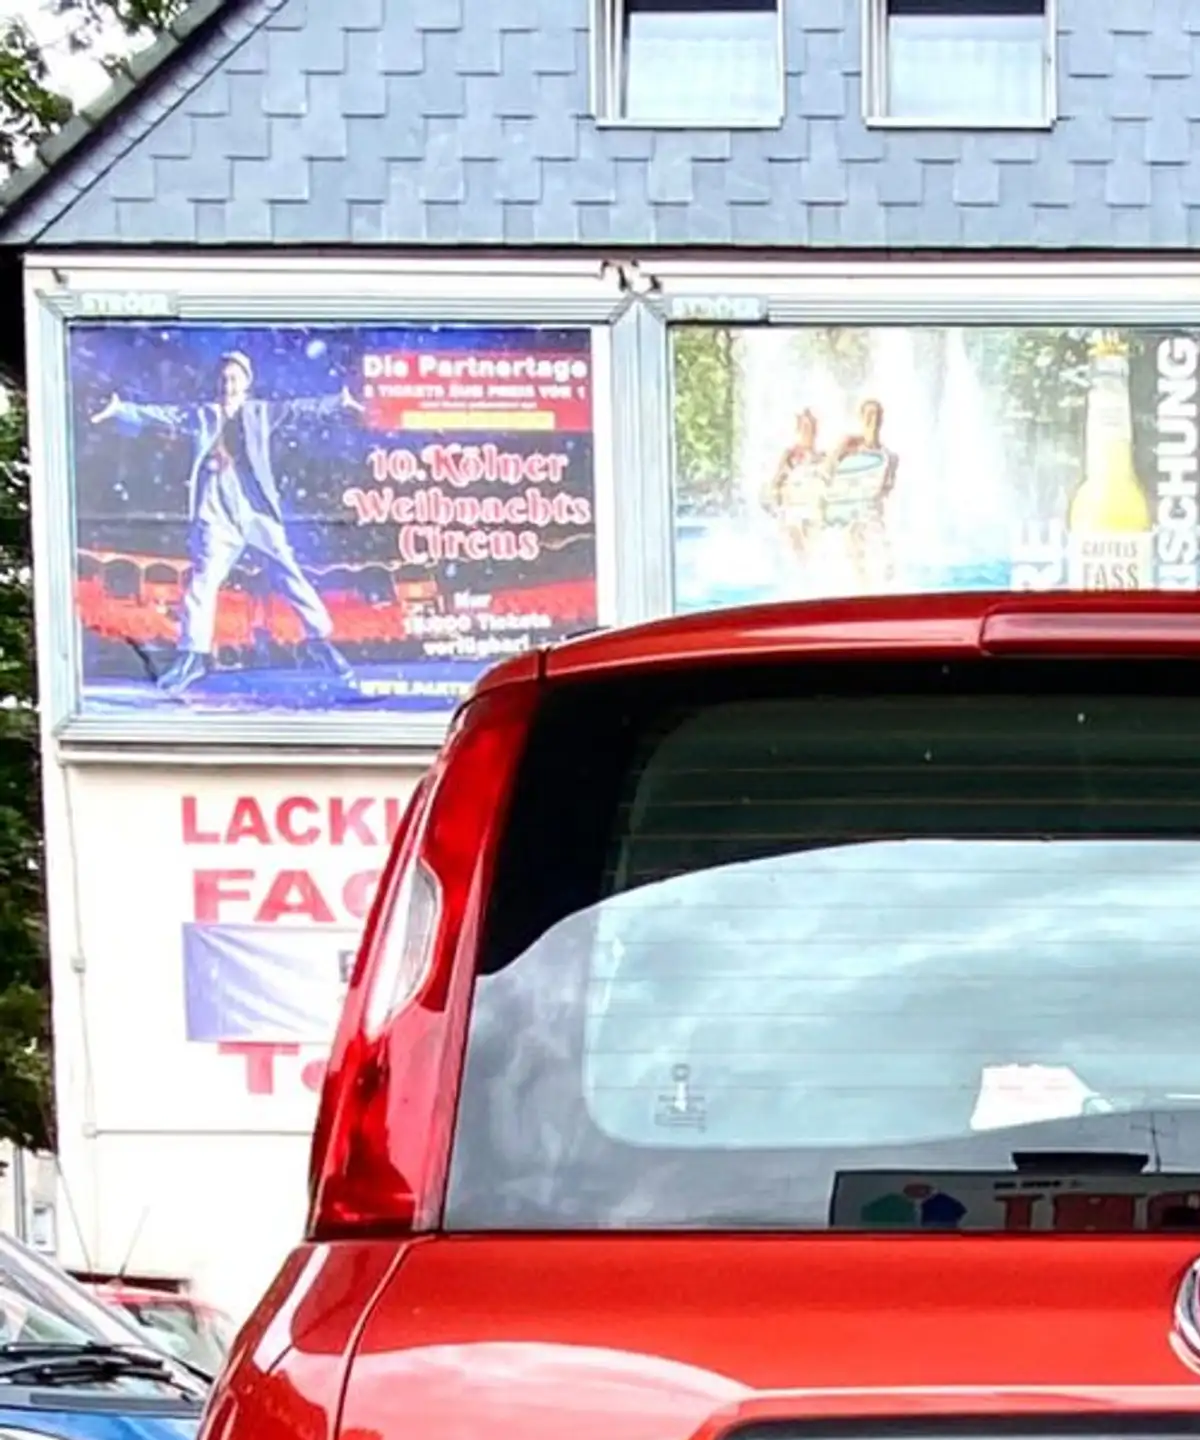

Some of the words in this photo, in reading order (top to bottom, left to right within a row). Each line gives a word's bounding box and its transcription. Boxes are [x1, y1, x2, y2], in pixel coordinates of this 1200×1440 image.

[363, 354, 409, 378] Die
[418, 354, 588, 382] Partnertage
[343, 487, 591, 527] Weihnachts
[399, 525, 540, 564] Circus
